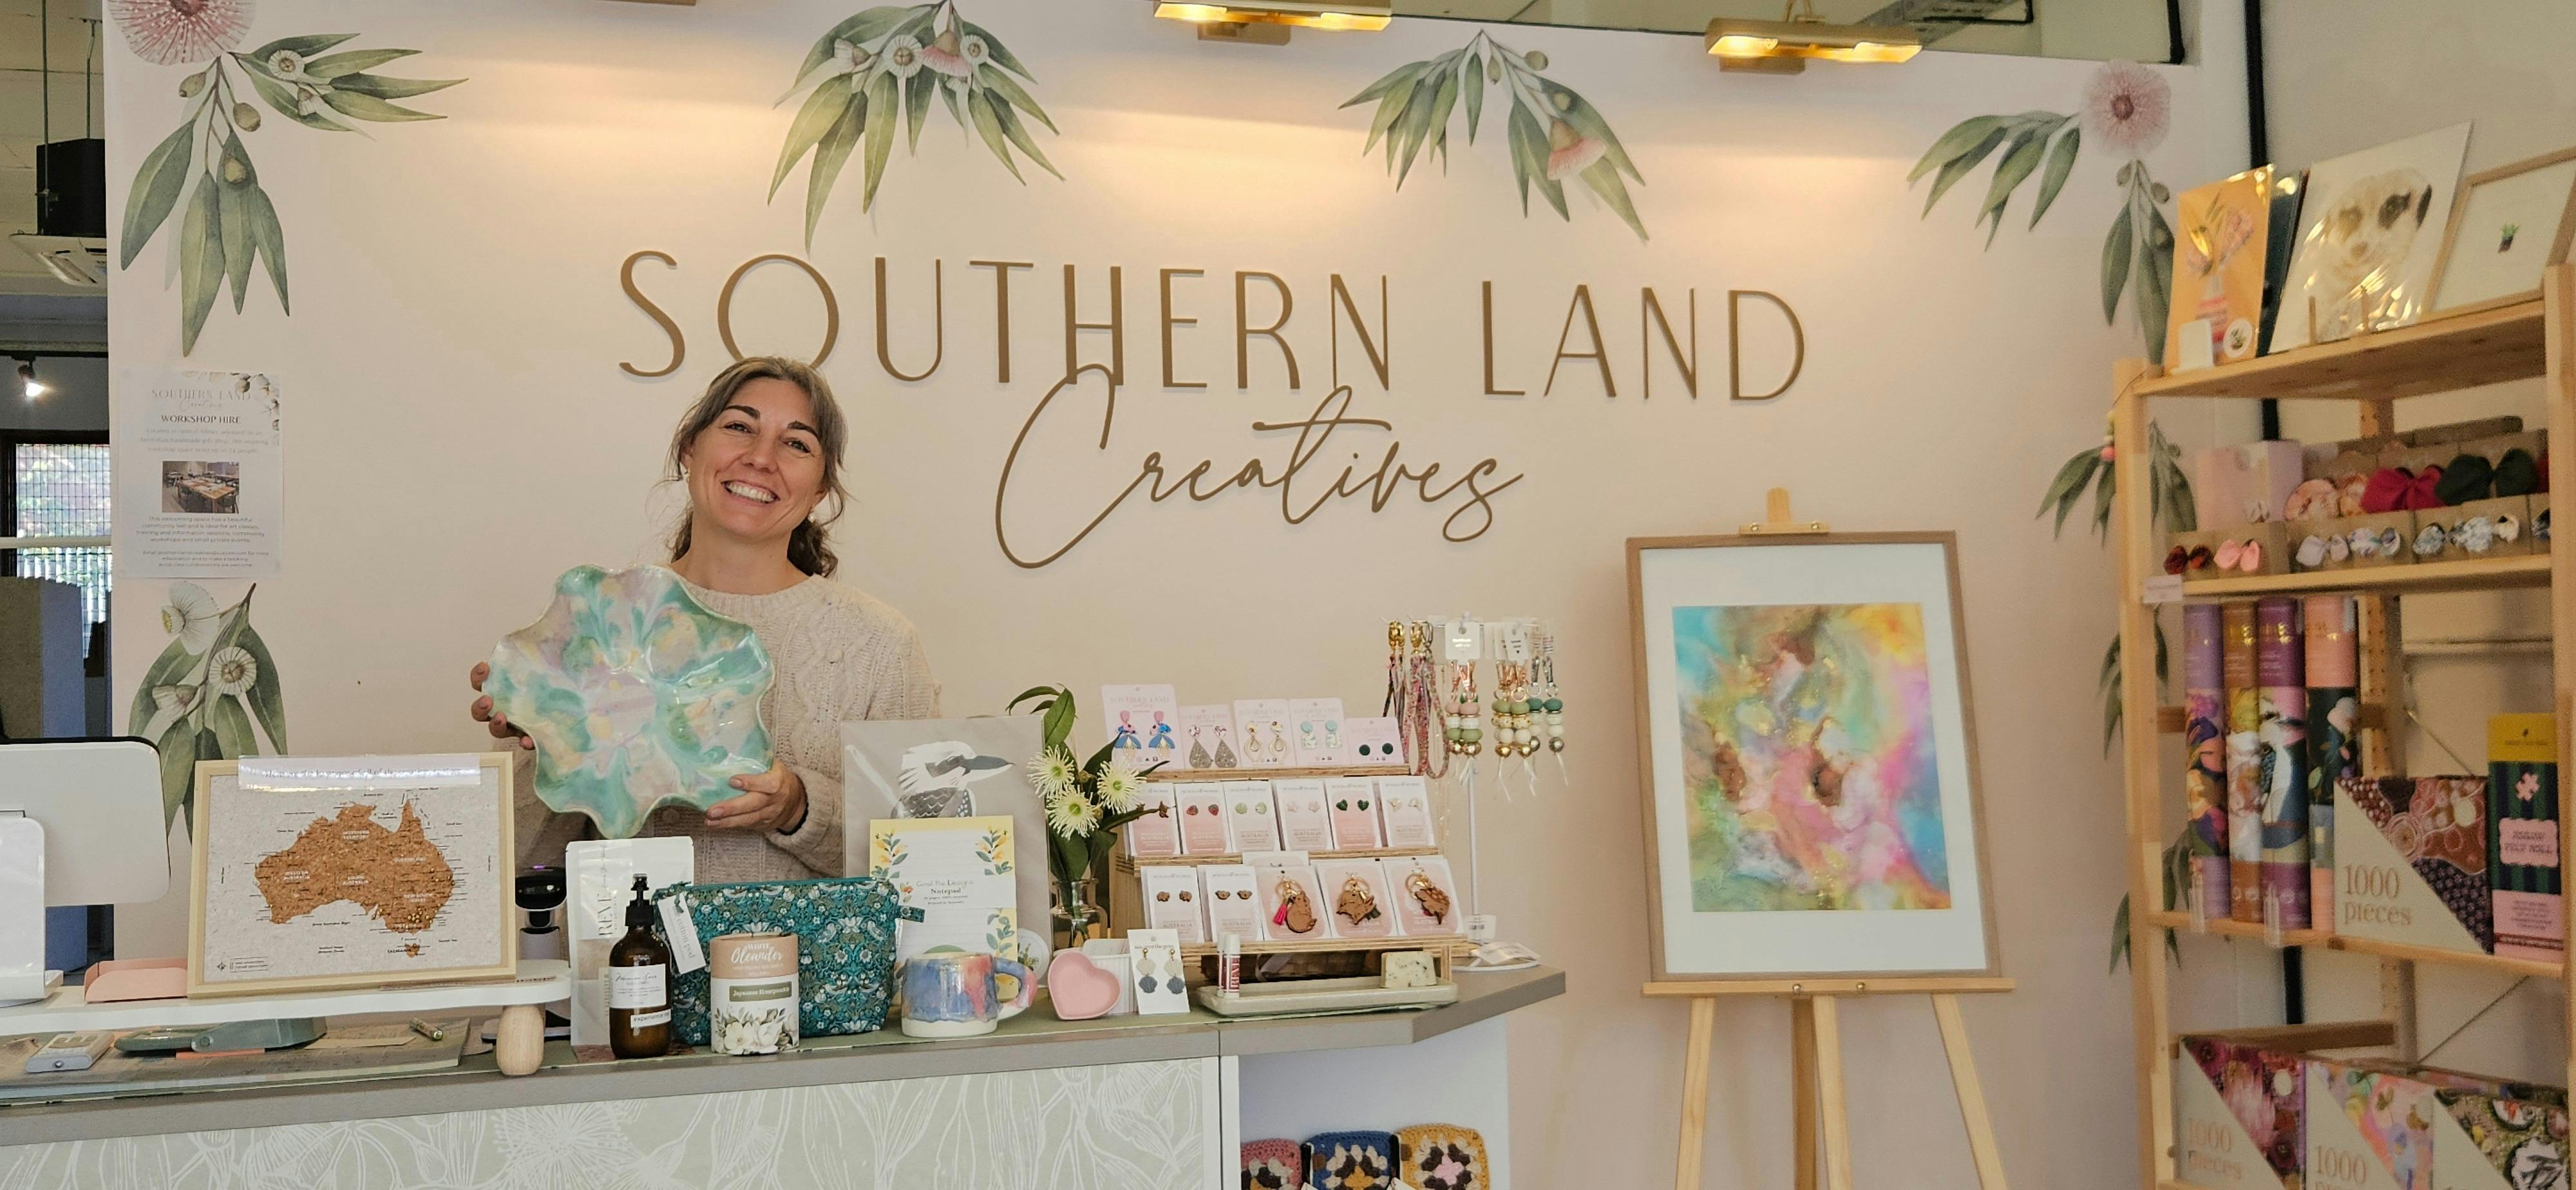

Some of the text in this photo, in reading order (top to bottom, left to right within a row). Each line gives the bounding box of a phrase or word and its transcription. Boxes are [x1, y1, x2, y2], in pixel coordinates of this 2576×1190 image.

[620, 250, 1805, 401] SOUTHERN LAND
[161, 415, 216, 423] WORKSHOP
[995, 364, 1525, 570] Creatives
[2343, 864, 2400, 899] 1000
[2344, 902, 2412, 926] pieces
[685, 943, 696, 959] pod
[731, 946, 783, 964] Oleander
[2316, 1144, 2367, 1185] 1000
